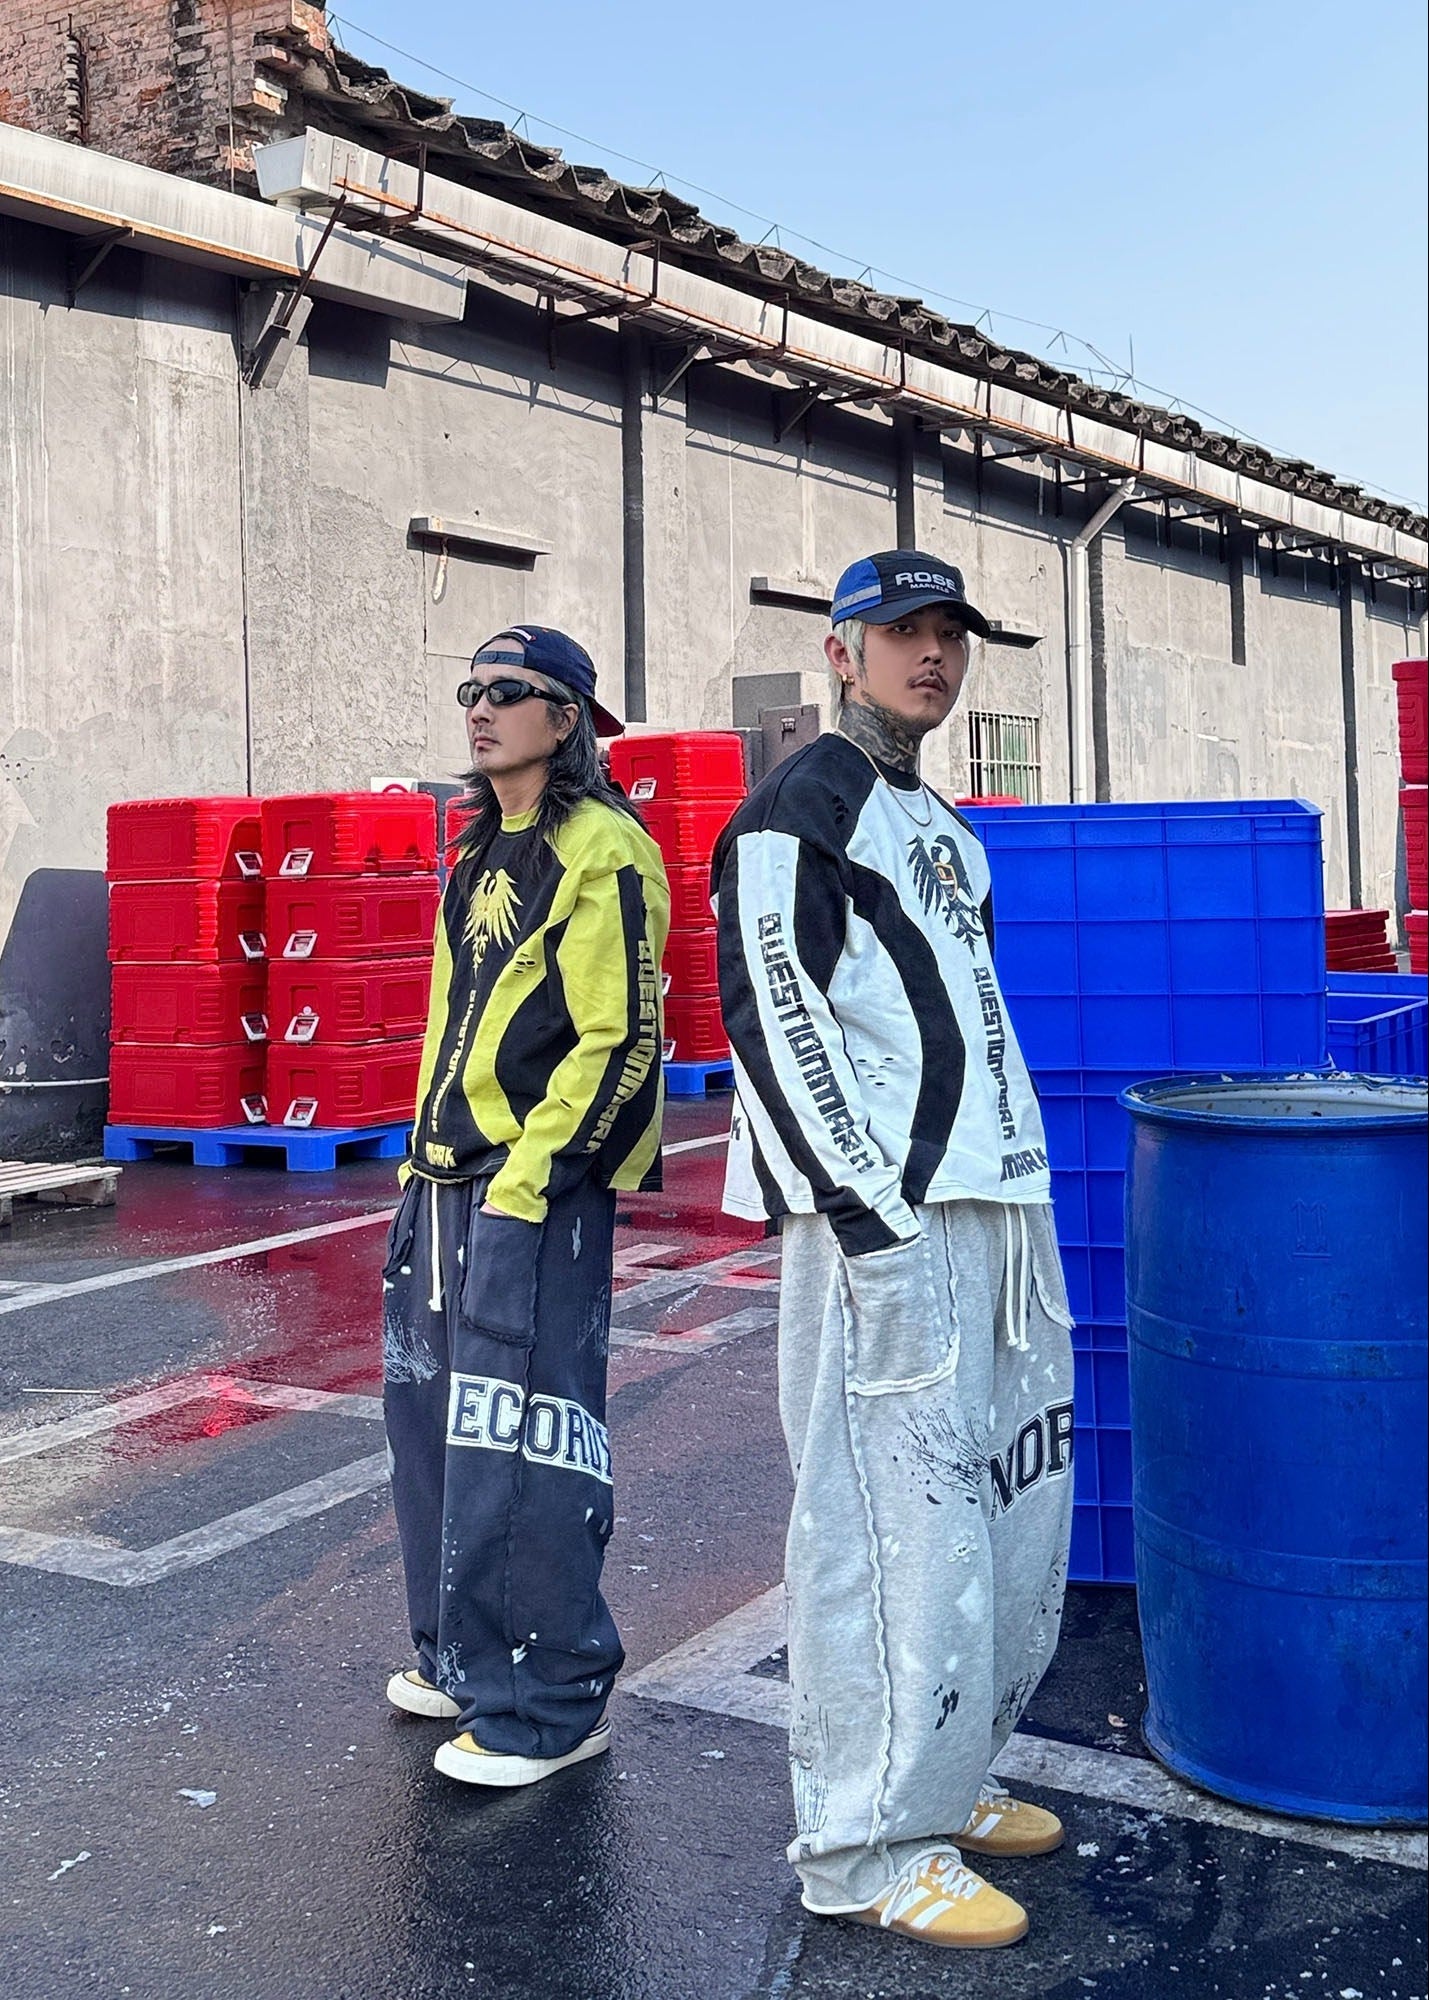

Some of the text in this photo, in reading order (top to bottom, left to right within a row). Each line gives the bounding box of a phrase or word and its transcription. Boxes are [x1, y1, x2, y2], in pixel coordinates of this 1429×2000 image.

[895, 572, 957, 592] ROSE
[910, 583, 950, 594] MARVELS
[583, 940, 657, 1154] QUESTIONMARK
[757, 912, 876, 1174] QUESTIONMARK
[972, 966, 1017, 1140] QUESTIONMARK
[1000, 1147, 1048, 1182] MARK
